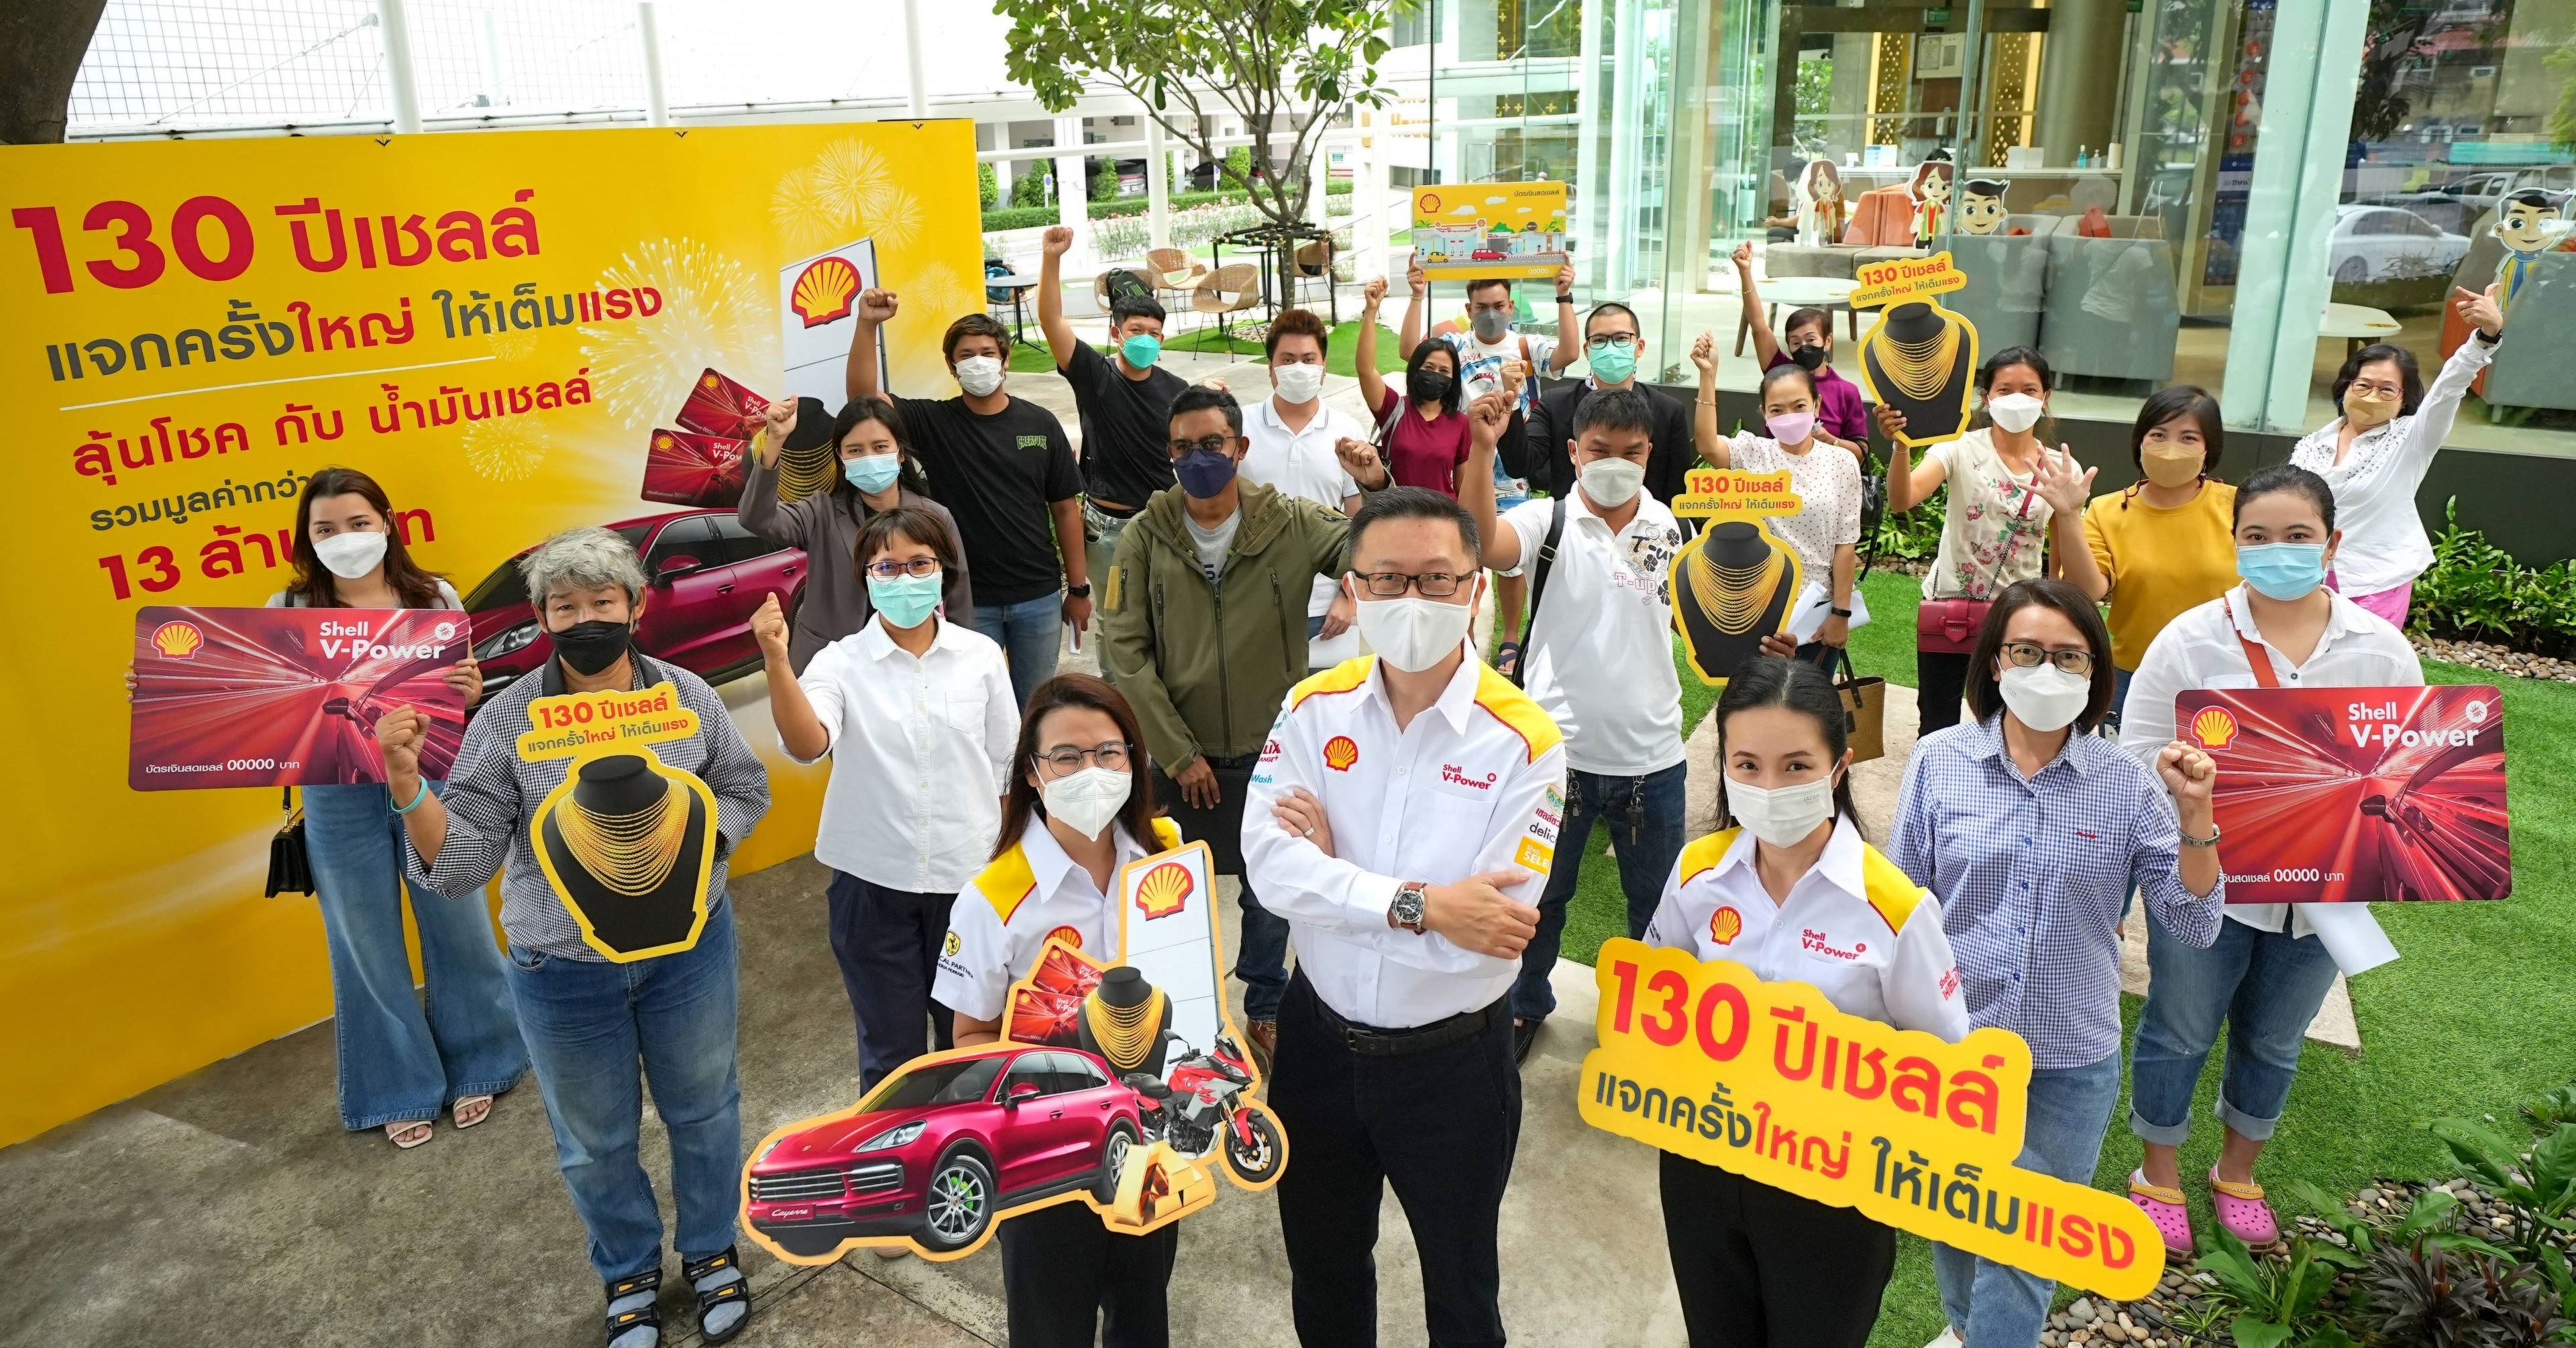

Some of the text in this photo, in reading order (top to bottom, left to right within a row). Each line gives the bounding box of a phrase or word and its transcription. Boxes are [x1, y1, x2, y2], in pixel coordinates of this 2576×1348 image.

[11, 188, 540, 295] 130 ปีเชลล์
[1864, 258, 1946, 286] 130 ปีเชลล์
[1856, 274, 1960, 302] แจกครั้งใหญ่ ให้เต็มแรง
[46, 282, 662, 382] แจกครั้งใหญ่ ให้เต็มแรง
[72, 367, 591, 487] ลุ้นโชค กับ น้ำมันเชลล์
[713, 442, 731, 451] Shell
[1693, 476, 1784, 494] 130 ปีเชลล์
[1679, 497, 1795, 510] แจกครั้งใหญ่ ให้เต็มแรง
[99, 545, 181, 601] 13
[319, 621, 368, 636] Shell
[319, 638, 445, 659] V-Power
[539, 691, 668, 728] 130 ปีเชลล์
[2348, 701, 2397, 720] Shell
[527, 718, 688, 752] แจกครั้งใหญ่ ให้เต็มแรง
[2349, 724, 2479, 748] V-Power
[146, 758, 300, 773] บัตรเงินสดเชลล์ 00000 บาท
[1443, 764, 1462, 773] Shell
[1442, 771, 1491, 789] V-Power
[1527, 844, 1541, 854] Shell
[2273, 868, 2320, 882] 00000
[2324, 873, 2345, 881] บาท
[1803, 929, 1826, 942] Shell
[1802, 938, 1860, 960] V-Power
[1613, 960, 2004, 1135] 130 ปีเชลล์
[1596, 1072, 2135, 1269] แจกครั้งใหญ่ ให้เต็มแรง
[2154, 1190, 2180, 1200] ADDA
[2232, 1186, 2255, 1195] ADDA
[771, 1209, 808, 1219] Cayenne
